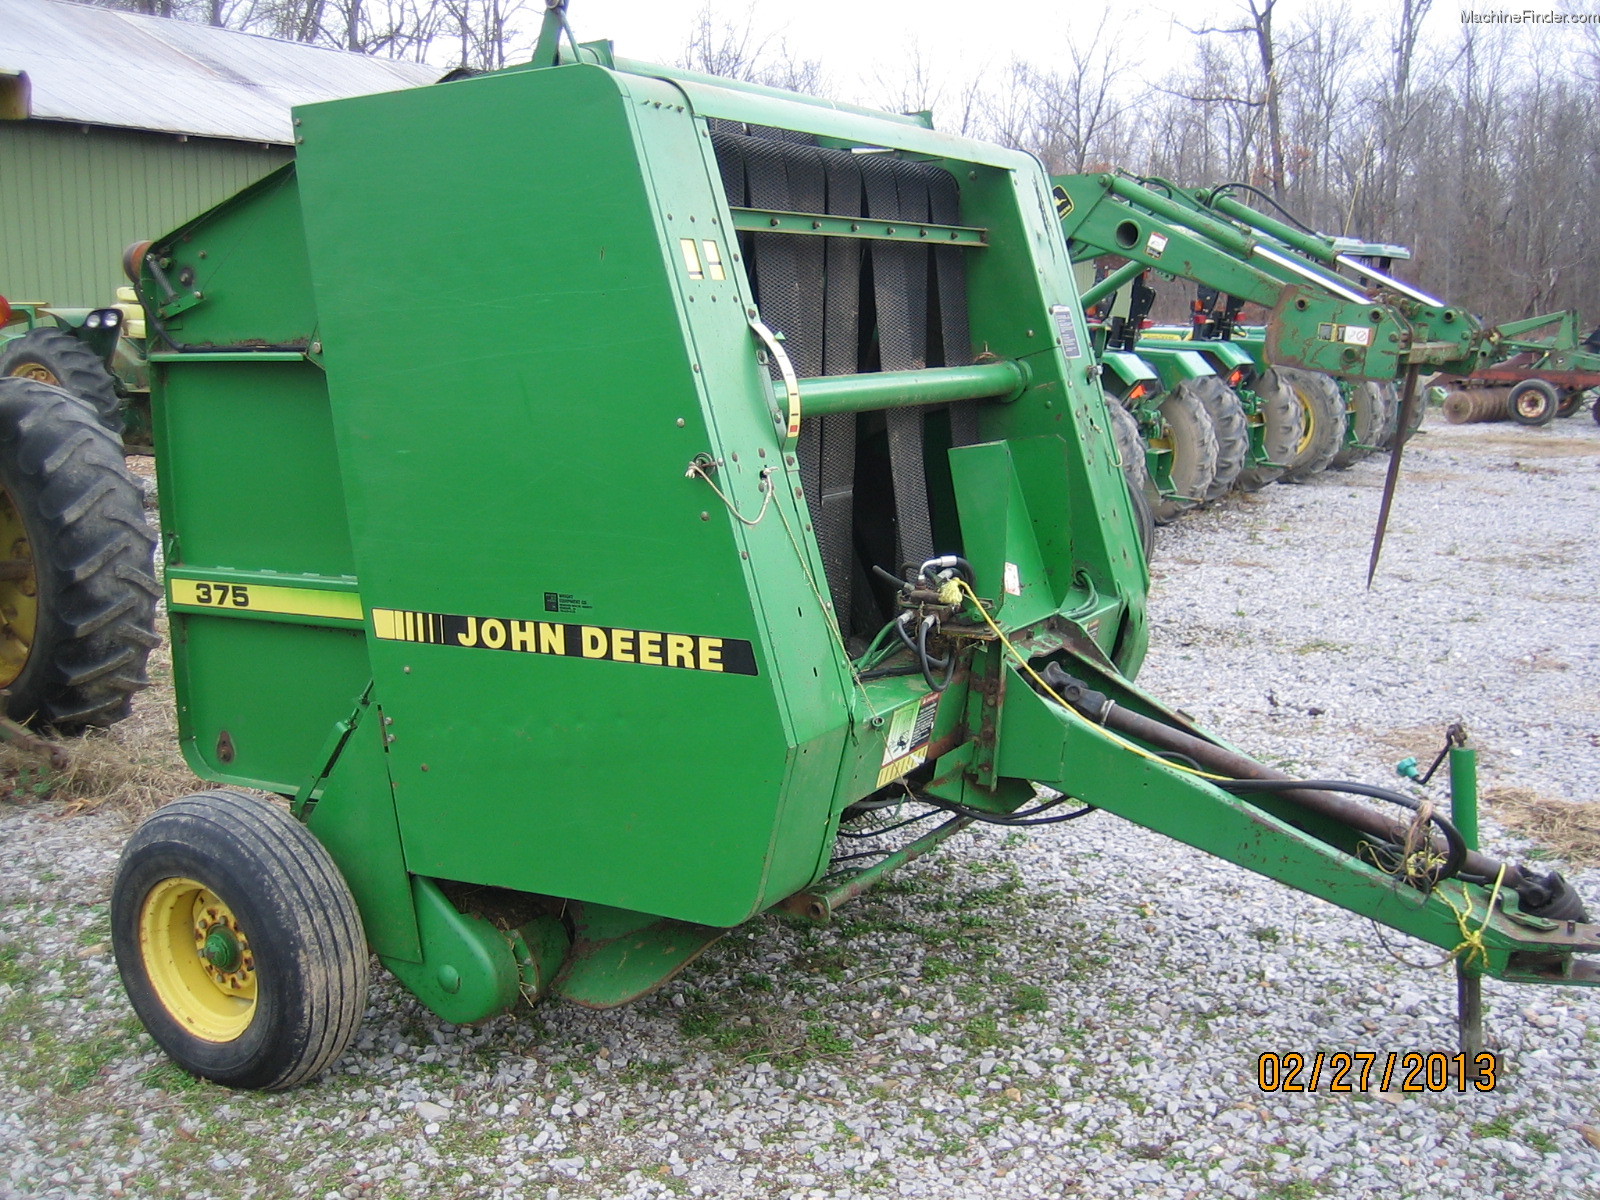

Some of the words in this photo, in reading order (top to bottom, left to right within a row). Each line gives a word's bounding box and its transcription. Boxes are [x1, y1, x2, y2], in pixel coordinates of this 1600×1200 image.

[196, 583, 249, 607] 375
[457, 616, 565, 655] JOHN
[581, 626, 724, 672] DEERE
